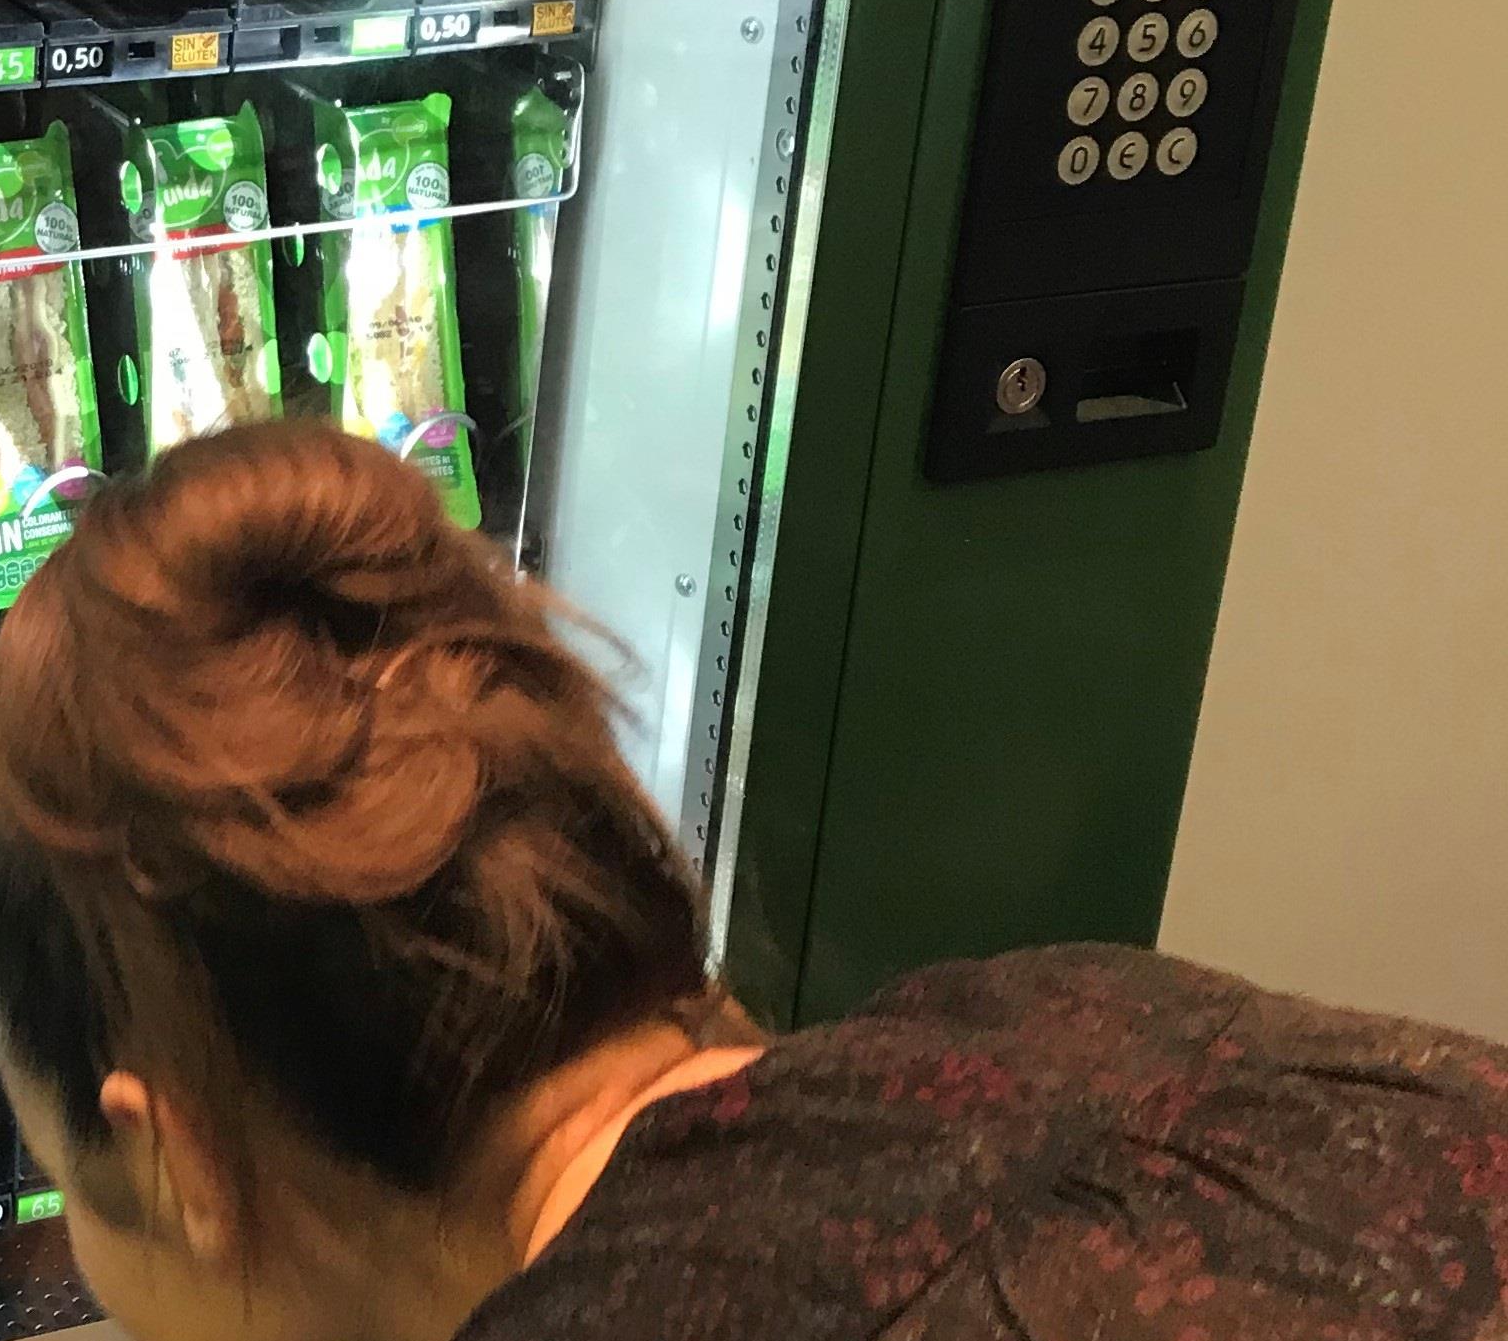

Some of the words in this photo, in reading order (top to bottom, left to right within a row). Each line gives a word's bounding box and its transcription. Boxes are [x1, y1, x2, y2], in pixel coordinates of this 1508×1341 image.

[536, 5, 557, 20] SIN
[420, 13, 471, 40] 0,50
[174, 36, 197, 51] SIN
[1088, 27, 1106, 56] 4
[1138, 23, 1157, 53] 5
[1188, 20, 1207, 49] 6
[52, 44, 103, 73] 0,50
[173, 49, 217, 64] GLUTEN
[1083, 87, 1100, 117] 7
[1129, 83, 1147, 111] 8
[1179, 78, 1197, 107] 9
[1070, 146, 1089, 175] 0
[1168, 137, 1186, 165] C
[231, 192, 262, 209] 100%
[407, 186, 446, 202] NATURAL
[224, 205, 262, 220] NATURAL
[44, 215, 74, 233] 100%
[37, 228, 75, 242] NATURAL
[30, 1194, 62, 1217] 65
